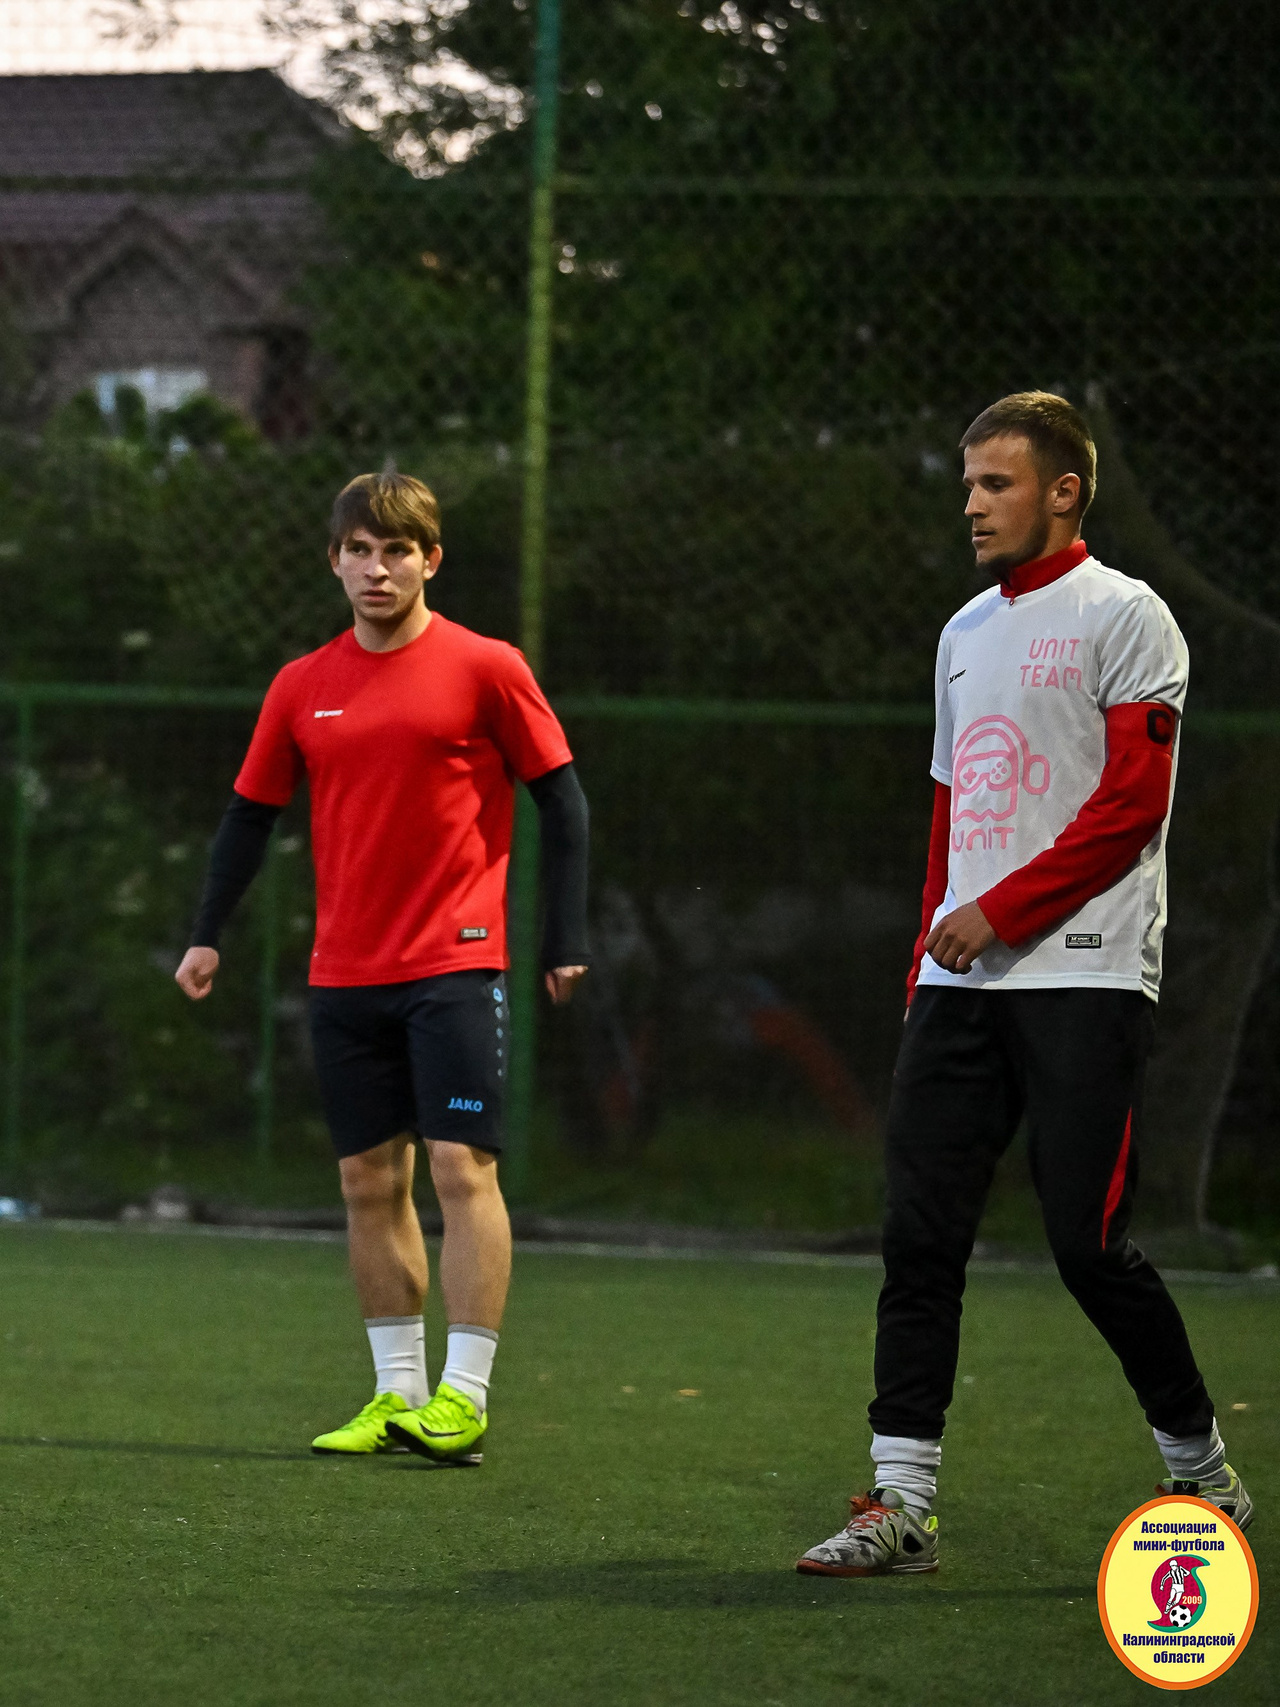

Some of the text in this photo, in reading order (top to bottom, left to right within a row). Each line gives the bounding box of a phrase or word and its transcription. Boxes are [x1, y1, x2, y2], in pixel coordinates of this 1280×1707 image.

[1028, 638, 1081, 661] UNIT
[1020, 664, 1082, 691] TEAM
[1147, 709, 1171, 746] C
[951, 827, 1015, 853] UNIT
[447, 1097, 483, 1113] JAKO
